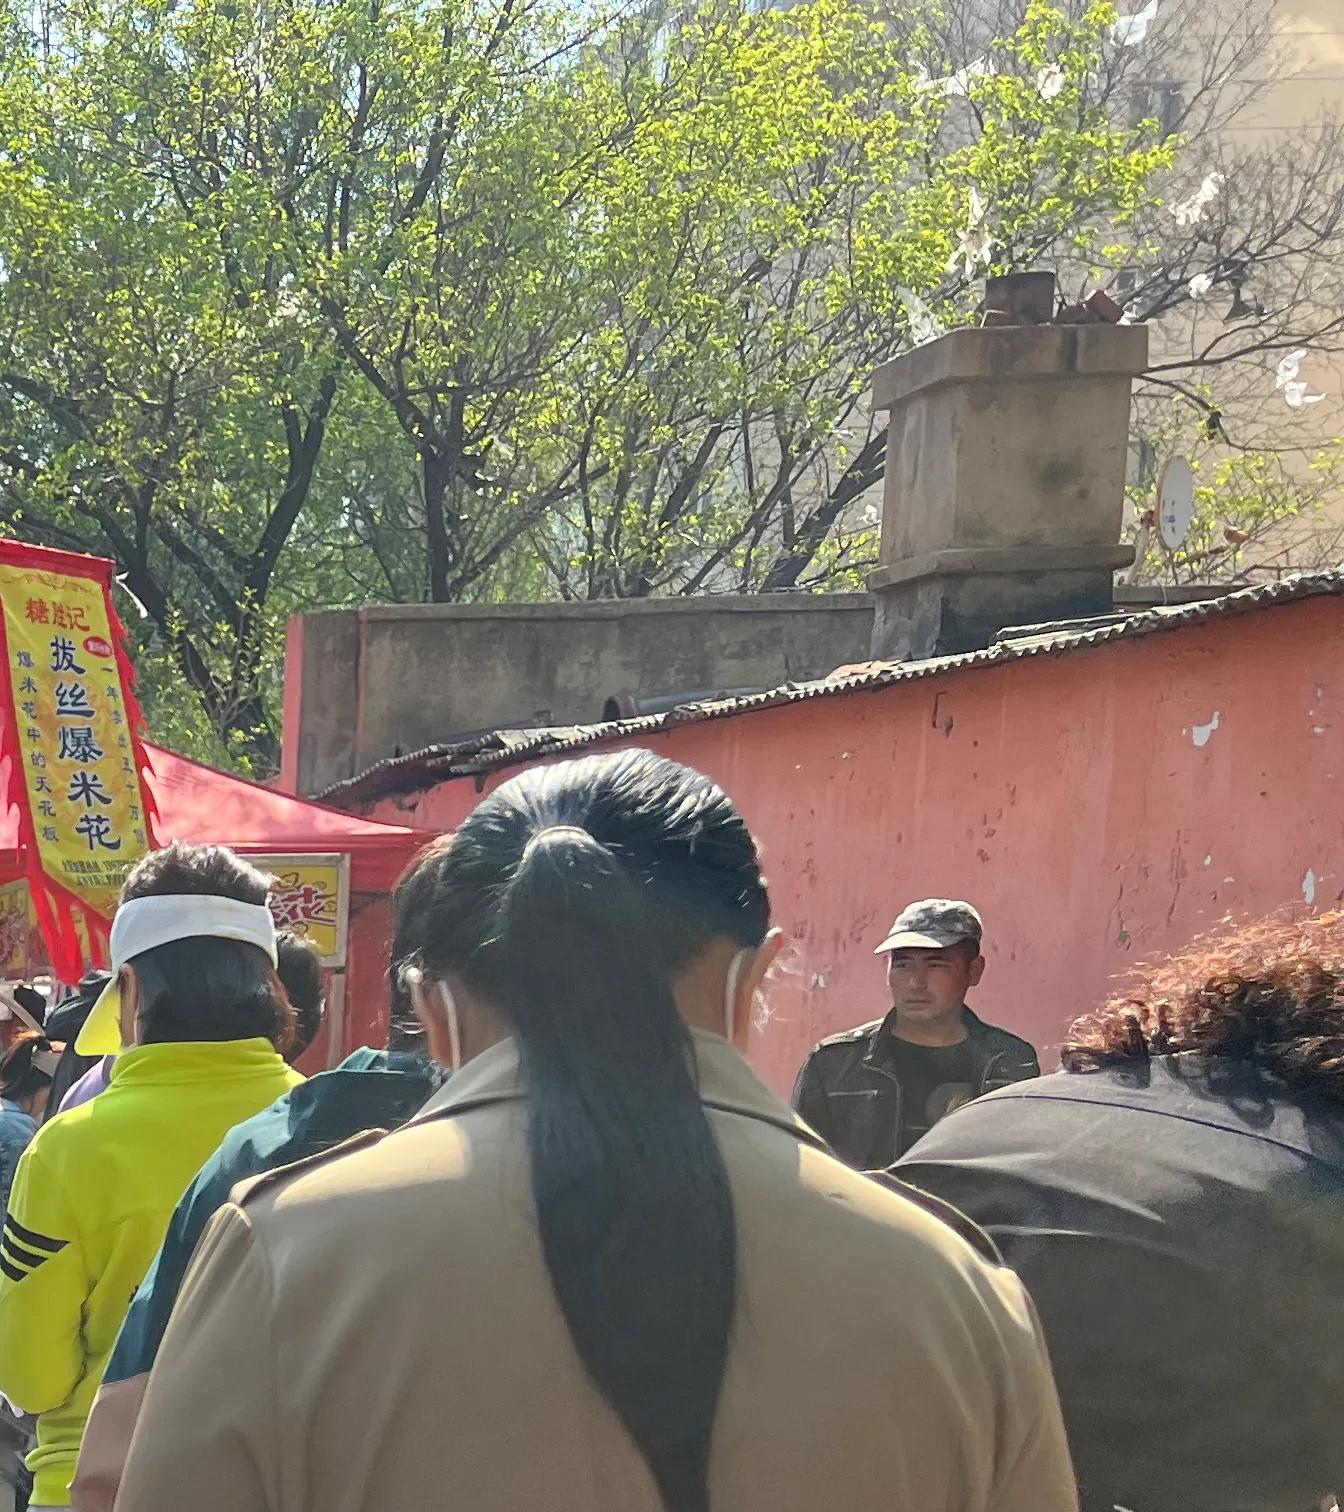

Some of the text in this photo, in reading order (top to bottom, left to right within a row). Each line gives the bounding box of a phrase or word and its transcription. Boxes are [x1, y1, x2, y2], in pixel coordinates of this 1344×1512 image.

[16, 650, 59, 842] 爆米花中的天花板
[50, 636, 122, 851] 拔丝爆米花
